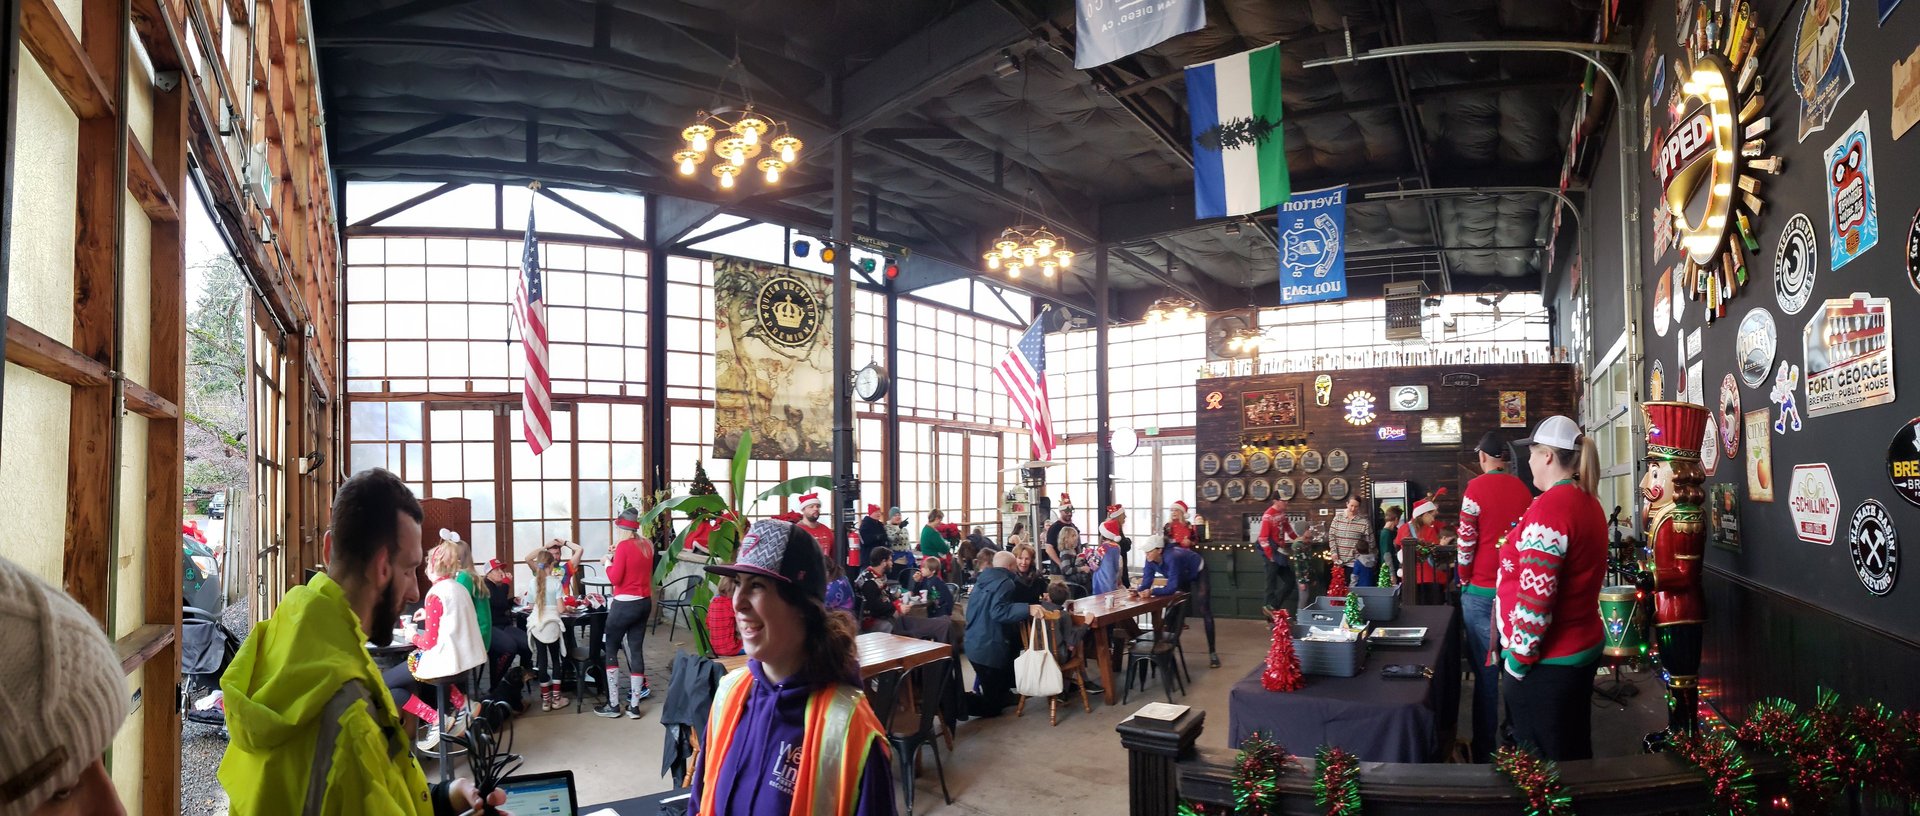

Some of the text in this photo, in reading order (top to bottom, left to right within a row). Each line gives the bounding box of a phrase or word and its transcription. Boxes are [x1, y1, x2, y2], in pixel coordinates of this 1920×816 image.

[761, 281, 814, 317] QUEEN ORCHARD
[766, 321, 811, 342] PREMIUM
[1808, 356, 1888, 396] FORT GEORGE
[1864, 377, 1889, 393] HOUSE
[1385, 426, 1406, 436] Beer
[1795, 496, 1830, 514] SCHILLING
[1850, 505, 1897, 551] KLAMATH BASIN
[1859, 566, 1892, 591] BREWING
[773, 755, 799, 782] Lin
